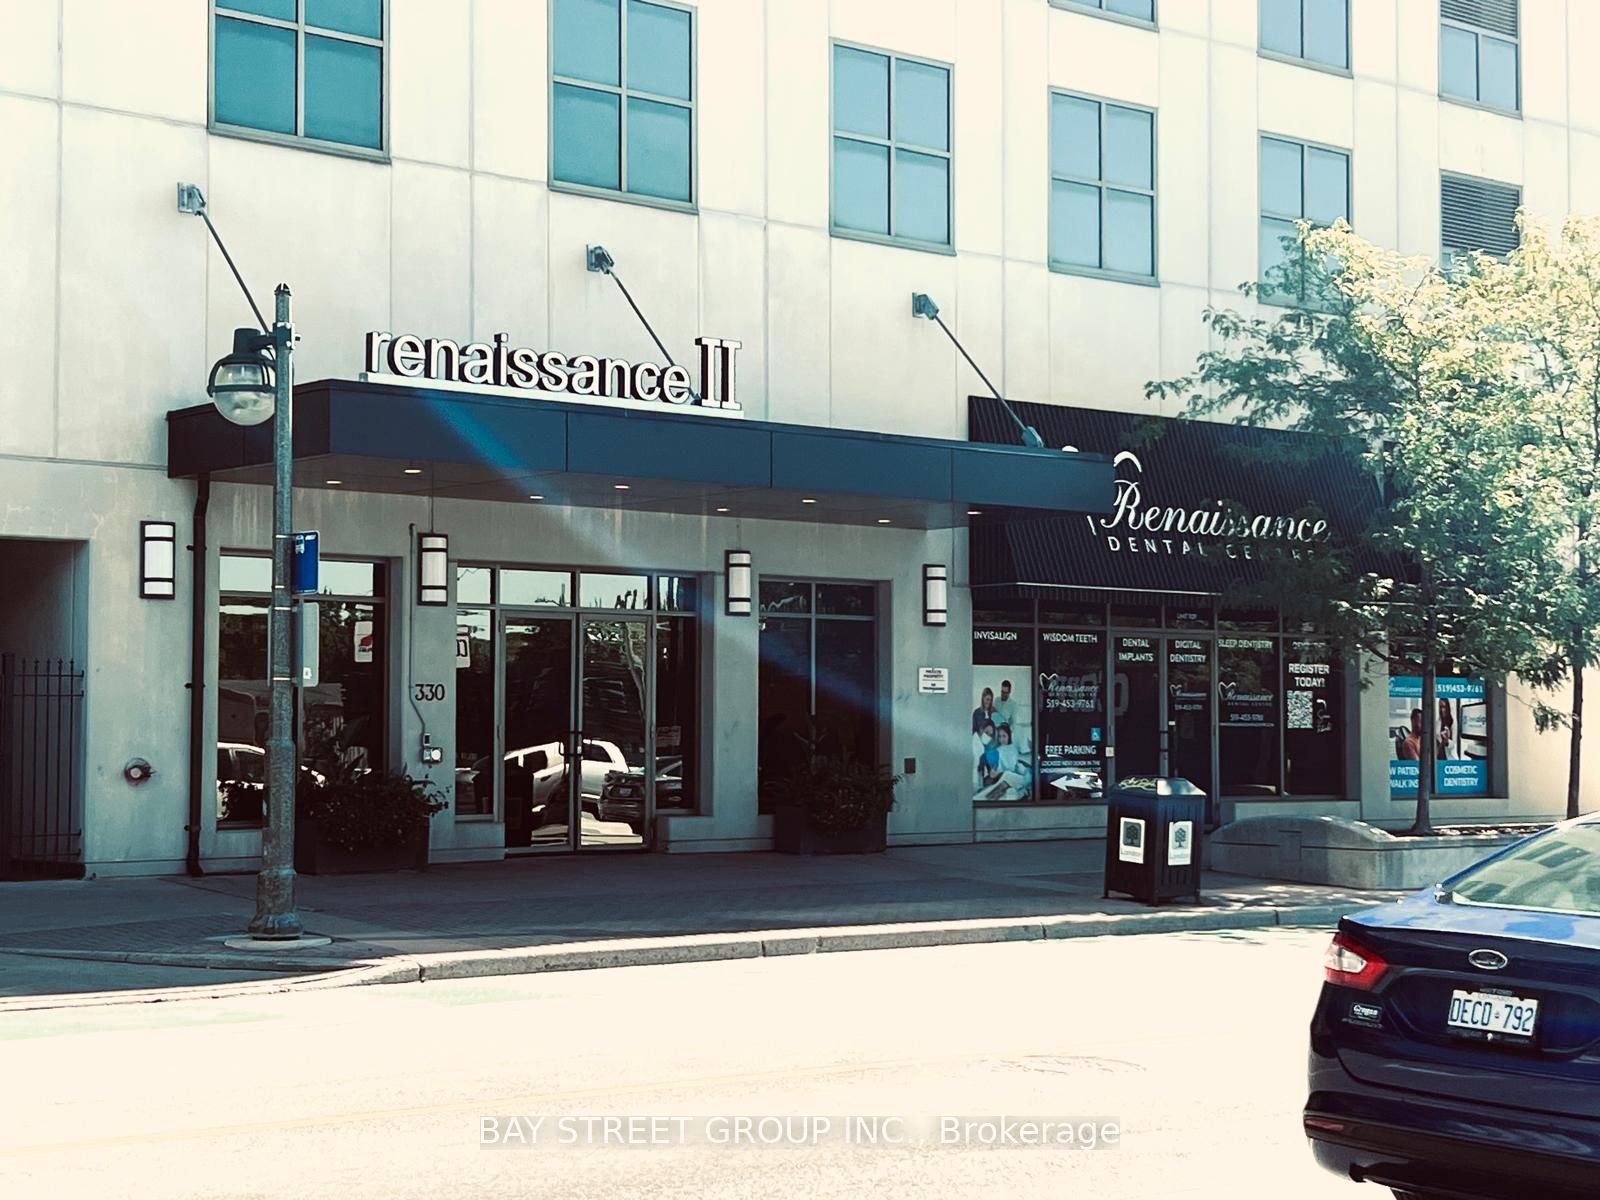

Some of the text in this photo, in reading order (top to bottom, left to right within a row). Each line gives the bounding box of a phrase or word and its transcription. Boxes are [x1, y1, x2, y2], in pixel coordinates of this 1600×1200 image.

[366, 330, 742, 410] renaissance II
[1100, 479, 1331, 543] Renaissance
[1107, 536, 1208, 557] DENTAL
[974, 631, 1018, 641] INVISALIGN
[1043, 632, 1098, 643] WISDOM TEETH
[1122, 638, 1150, 648] DENTAL
[1174, 640, 1202, 649] DIGITAL
[1118, 652, 1154, 662] IMPLANTS
[1169, 653, 1207, 663] DENTISTRY
[1288, 663, 1330, 675] REGISTER
[1294, 676, 1326, 688] TODAY!
[414, 683, 446, 701] 330
[1045, 744, 1097, 755] FREE PARKING
[1444, 765, 1478, 775] COSMETIC
[1443, 777, 1479, 787] DENTISTRY
[1503, 1004, 1534, 1032] 792
